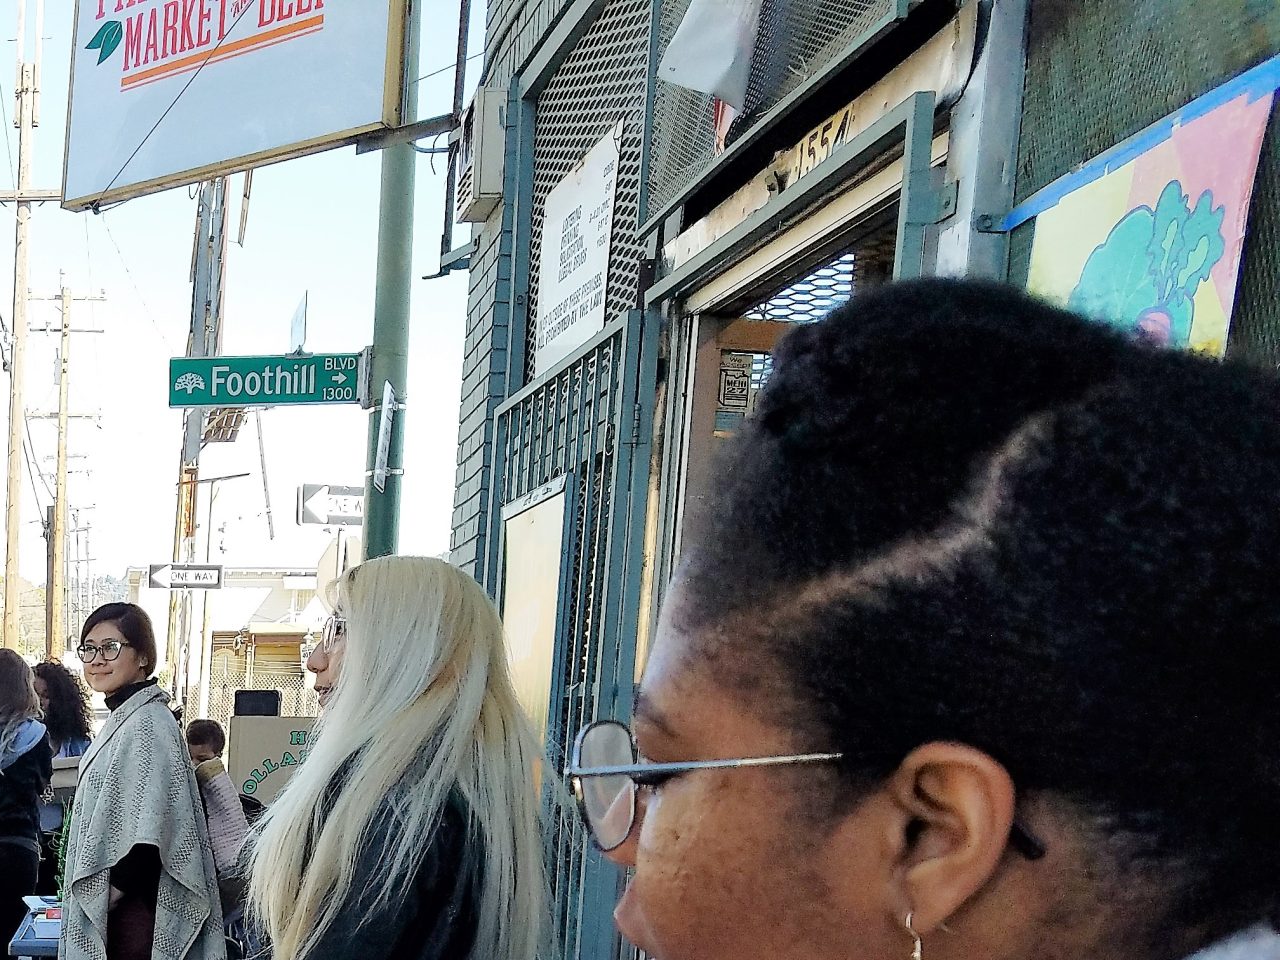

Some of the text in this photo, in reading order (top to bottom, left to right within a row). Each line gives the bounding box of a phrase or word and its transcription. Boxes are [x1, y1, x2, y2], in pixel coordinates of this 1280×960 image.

[122, 0, 228, 72] MARKET
[324, 358, 356, 371] BLVD
[210, 364, 315, 396] Foothill
[322, 388, 353, 400] 1300
[171, 572, 214, 581] ONE WAY
